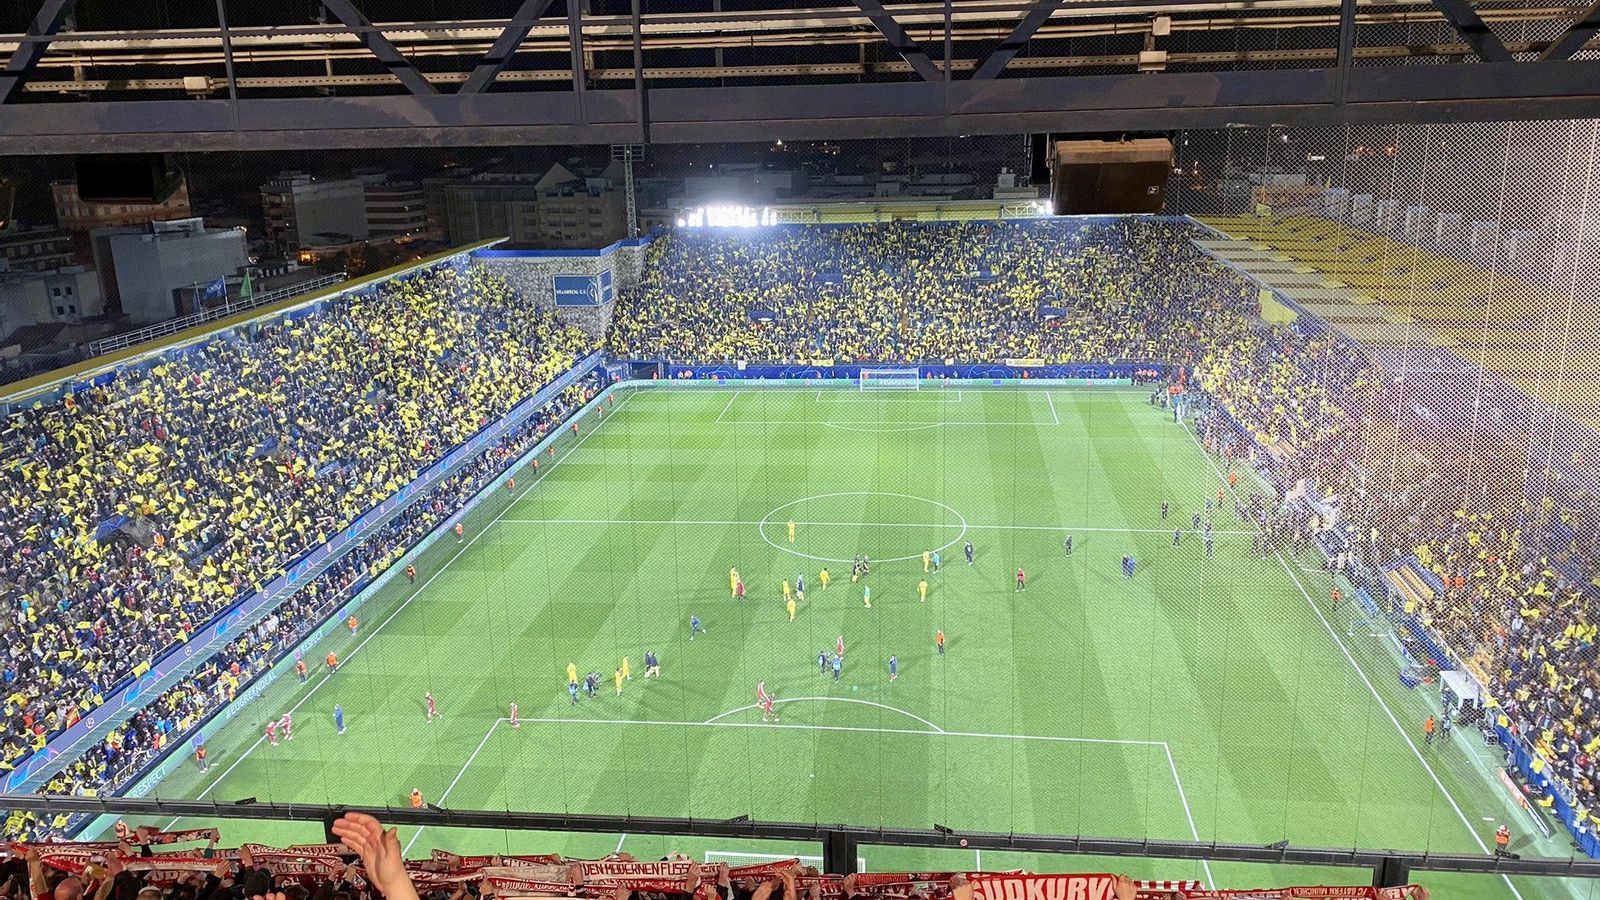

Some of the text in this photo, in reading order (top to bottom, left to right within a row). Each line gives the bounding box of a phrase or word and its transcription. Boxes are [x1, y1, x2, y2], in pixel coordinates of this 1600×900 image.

[132, 766, 167, 798] RESPECT
[584, 863, 604, 876] DEN
[605, 863, 660, 876] MODERNEN
